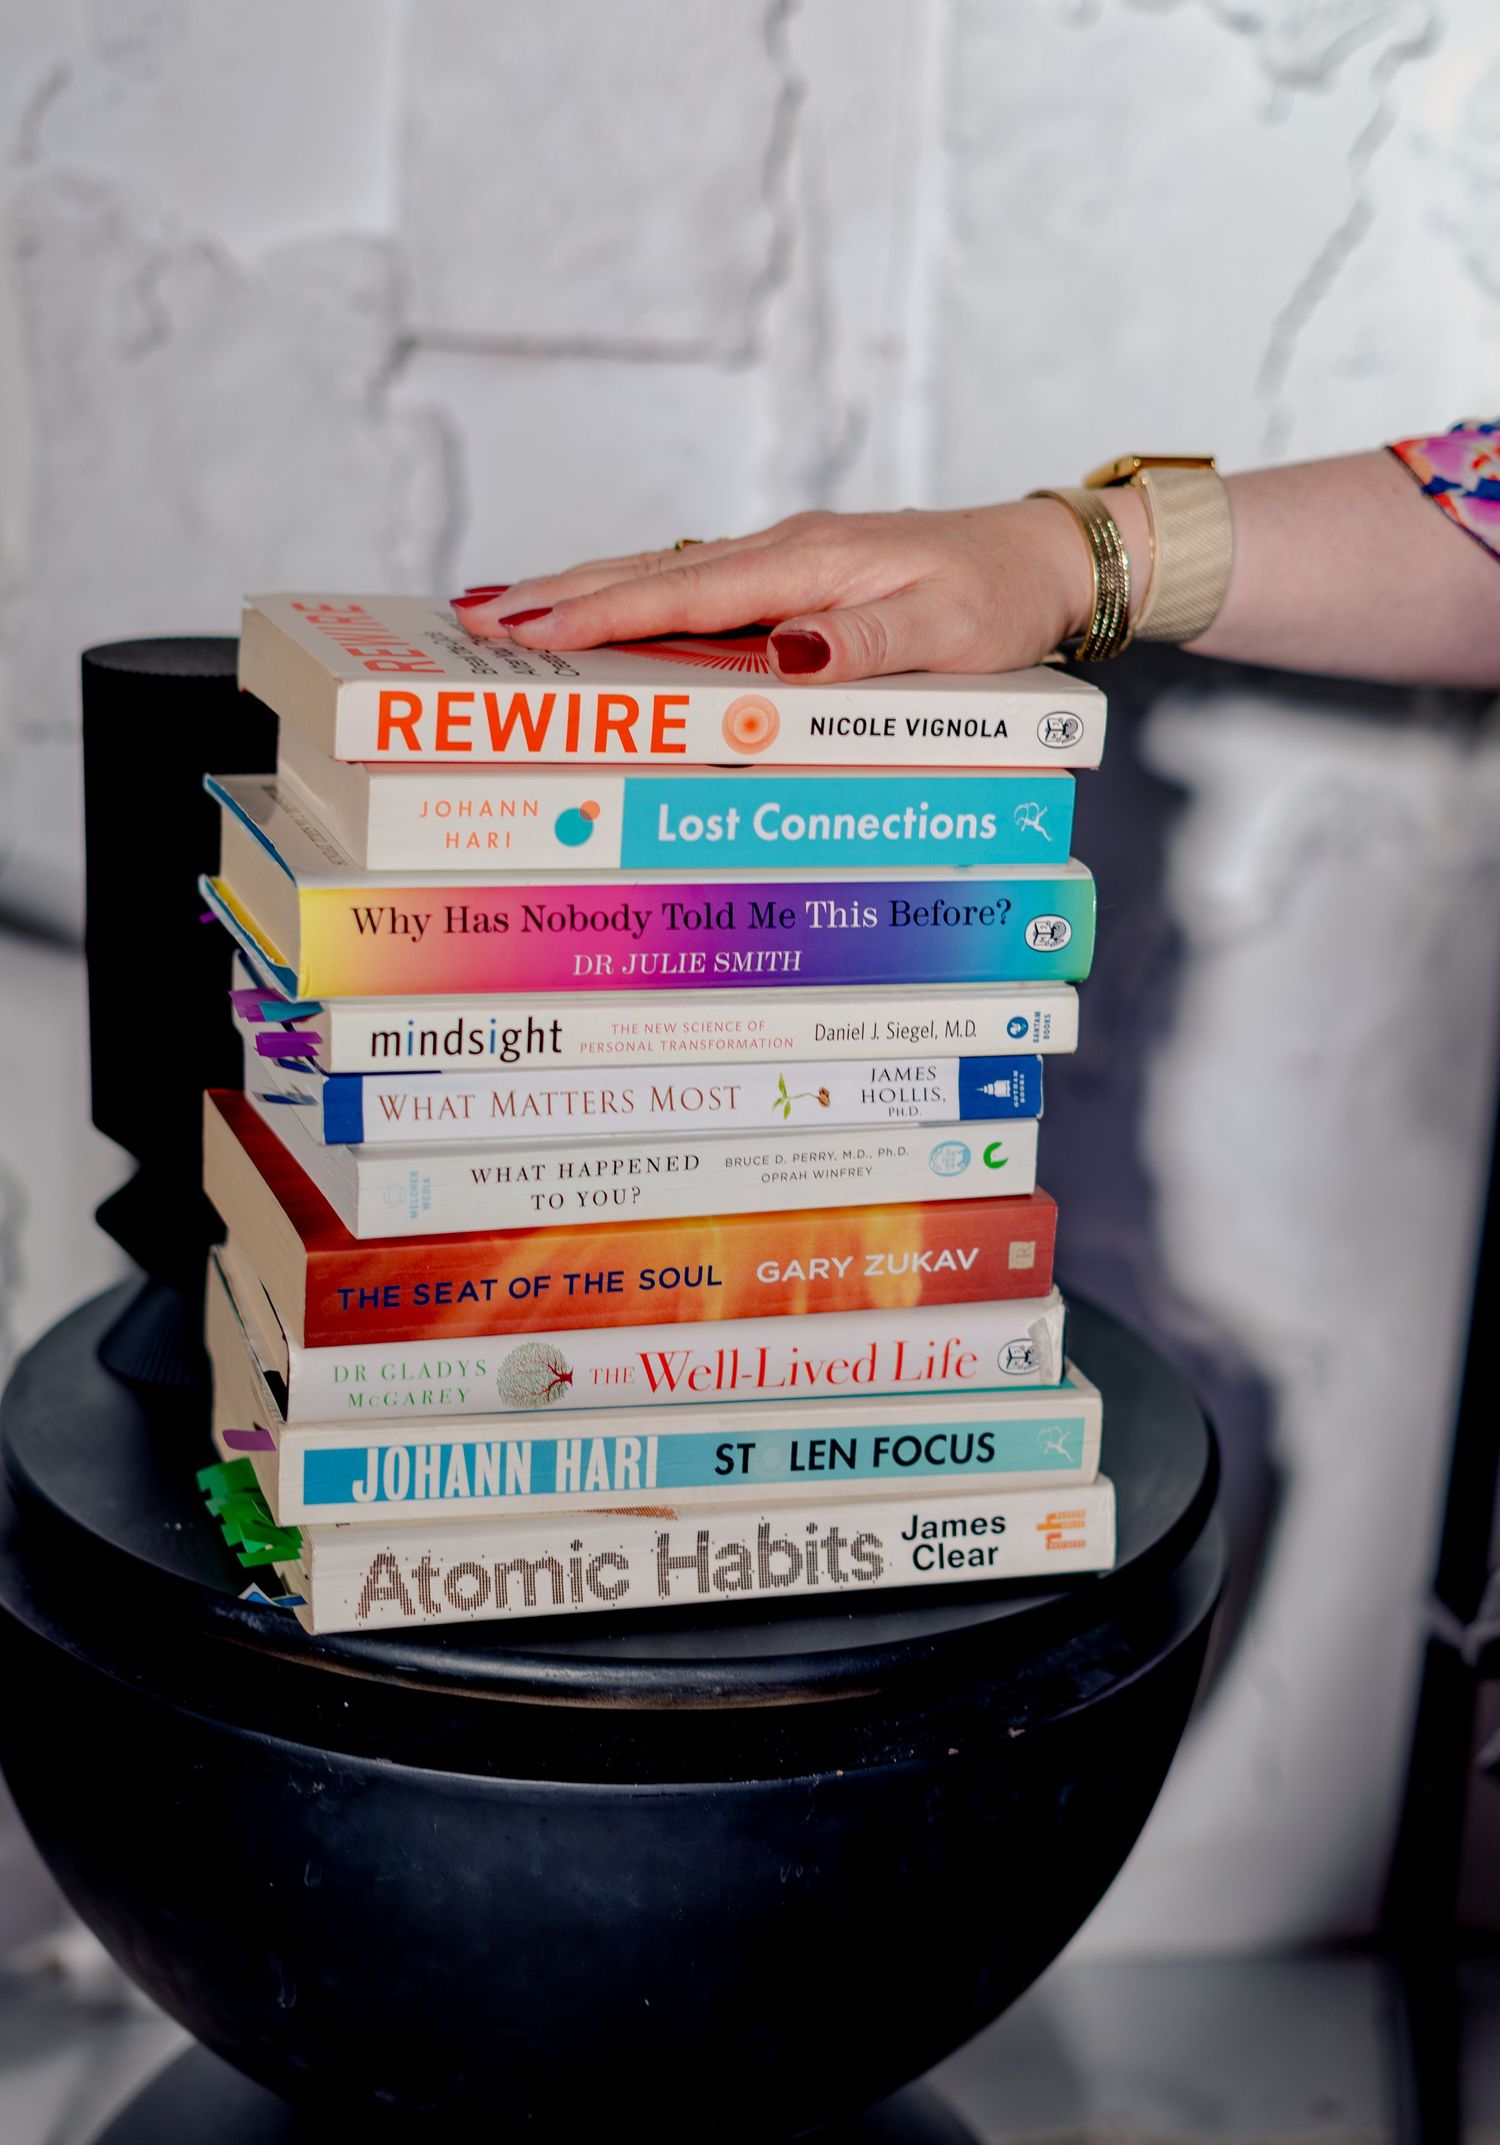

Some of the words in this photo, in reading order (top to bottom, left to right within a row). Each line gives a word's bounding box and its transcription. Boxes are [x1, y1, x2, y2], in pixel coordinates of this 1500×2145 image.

[291, 600, 446, 674] REWIRE
[377, 690, 690, 753] REWIRE
[810, 717, 896, 736] NICOLE
[905, 718, 1008, 738] VIGNOLA
[419, 800, 539, 818] JOHANN
[658, 803, 740, 841] Lost
[753, 801, 997, 841] Connections
[445, 832, 511, 848] HARI
[351, 906, 432, 943] Why
[444, 905, 509, 933] Has
[520, 903, 653, 939] Nobody
[661, 902, 735, 931] Told
[748, 901, 796, 929] Me
[805, 900, 877, 929] This
[889, 898, 1011, 928] Before?
[572, 954, 614, 976] DR
[621, 952, 706, 975] JULIE
[713, 950, 802, 973] SMITH
[371, 1016, 562, 1062] mindsight
[611, 1023, 638, 1034] THE
[644, 1022, 677, 1033] NEW
[683, 1020, 741, 1033] SCIENCE
[747, 1020, 766, 1031] OF
[815, 1021, 865, 1041] Daniel
[870, 1022, 879, 1040] J.
[886, 1020, 938, 1043] Siegel,
[945, 1019, 976, 1038] M.D.
[580, 1041, 654, 1053] PERSONAL
[660, 1037, 794, 1051] TRANSFORMATION
[871, 1065, 937, 1083] JAMES
[376, 1093, 476, 1121] WHAT
[490, 1088, 635, 1118] MATTERS
[649, 1085, 742, 1113] MOST
[861, 1086, 946, 1104] HOLLIS,
[471, 1164, 547, 1185] WHAT
[558, 1154, 701, 1179] HAPPENED
[725, 1155, 770, 1167] BRUCE
[775, 1154, 787, 1164] D.
[792, 1151, 838, 1163] PERRY,
[878, 1147, 910, 1157] Ph.D.
[761, 1168, 808, 1183] OPRAH
[813, 1166, 873, 1179] WINFREY
[531, 1192, 564, 1211] TO
[576, 1186, 641, 1208] YOU?
[756, 1256, 854, 1283] GARY
[864, 1248, 979, 1276] ZUKAV
[337, 1284, 401, 1311] THE
[412, 1279, 498, 1306] SEAT
[508, 1274, 552, 1299] OF
[563, 1271, 625, 1295] THE
[639, 1265, 722, 1290] SOUL
[333, 1365, 368, 1383] DR
[381, 1359, 488, 1381] GLADYS
[589, 1366, 635, 1385] THE
[635, 1341, 879, 1394] Well-Lived
[893, 1337, 977, 1381] Life
[873, 1432, 995, 1468] FOCUS
[352, 1440, 532, 1502] JOHANN
[555, 1436, 659, 1492] HARI
[901, 1514, 1006, 1541] James
[355, 1540, 630, 1619] Atomic
[655, 1521, 884, 1597] Habits
[912, 1543, 999, 1570] Clear
